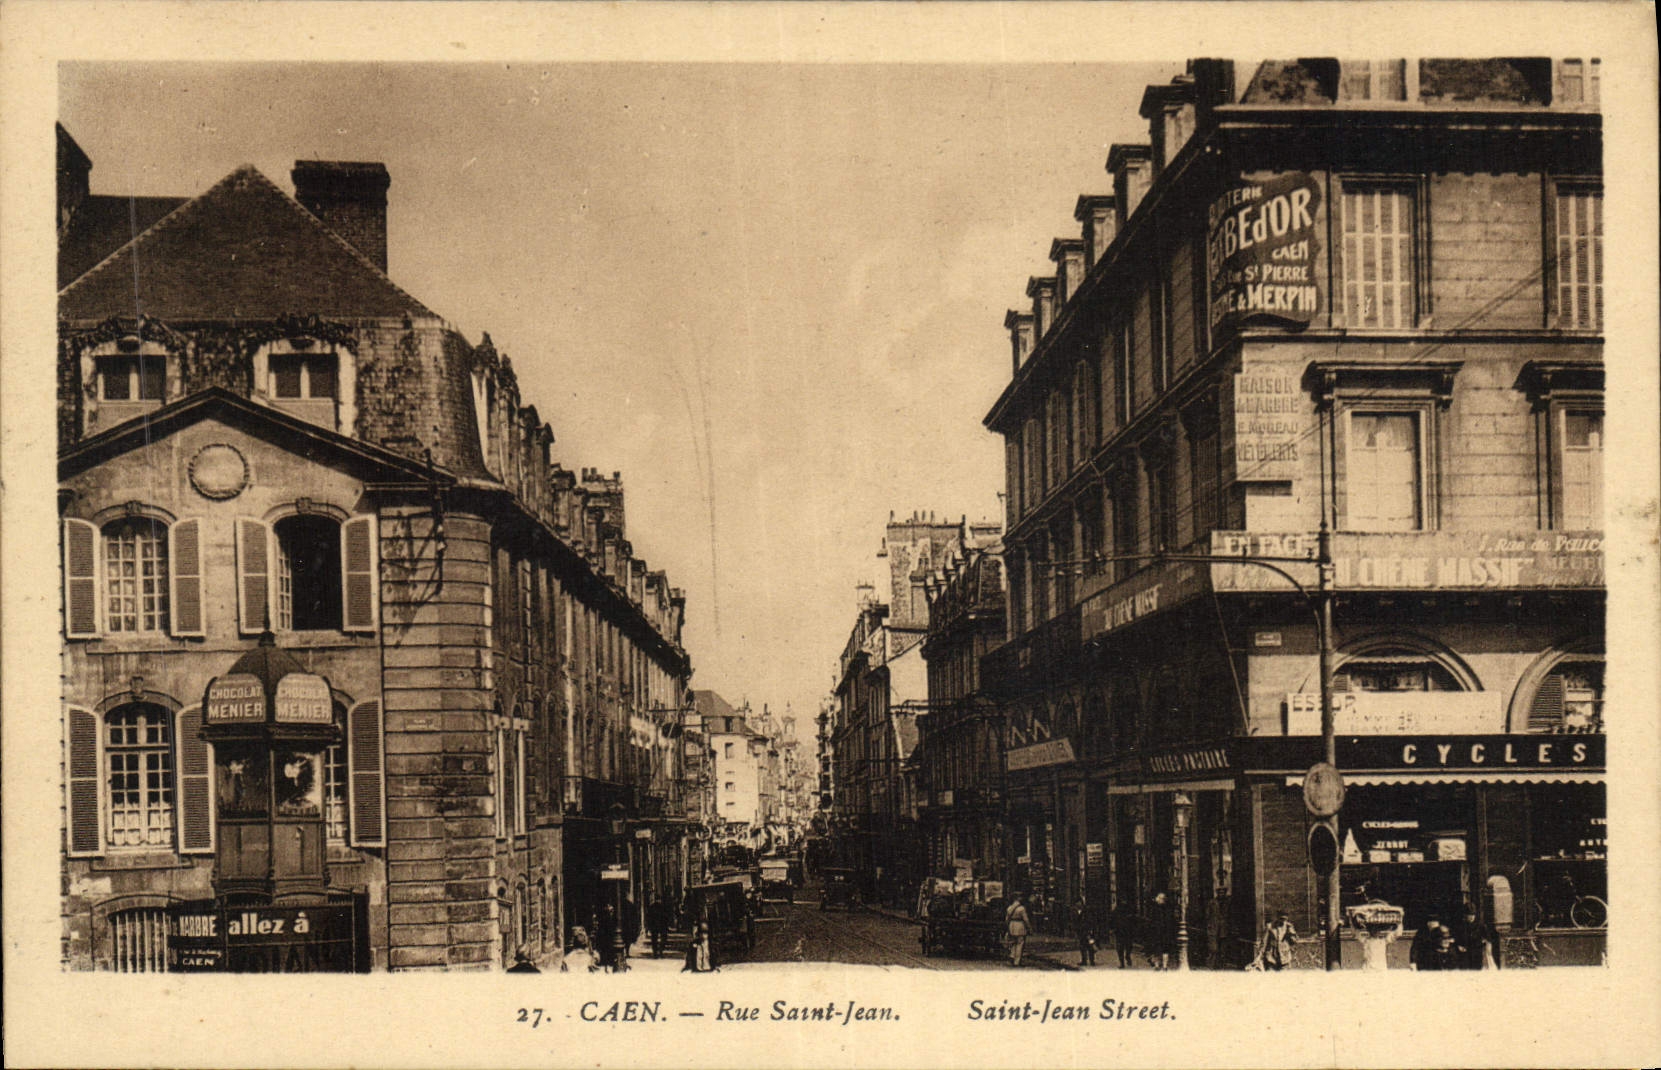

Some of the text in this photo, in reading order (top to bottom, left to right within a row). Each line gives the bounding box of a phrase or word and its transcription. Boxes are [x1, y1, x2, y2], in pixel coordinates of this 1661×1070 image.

[1272, 240, 1309, 260] CAEN
[1262, 264, 1308, 281] PIERRE
[209, 686, 262, 699] CHOCOLAT
[208, 703, 263, 719] MENIER
[277, 704, 331, 719] MENIER
[1403, 743, 1587, 765] CYCLES
[228, 911, 310, 935] allez à
[182, 957, 215, 966] CAEN
